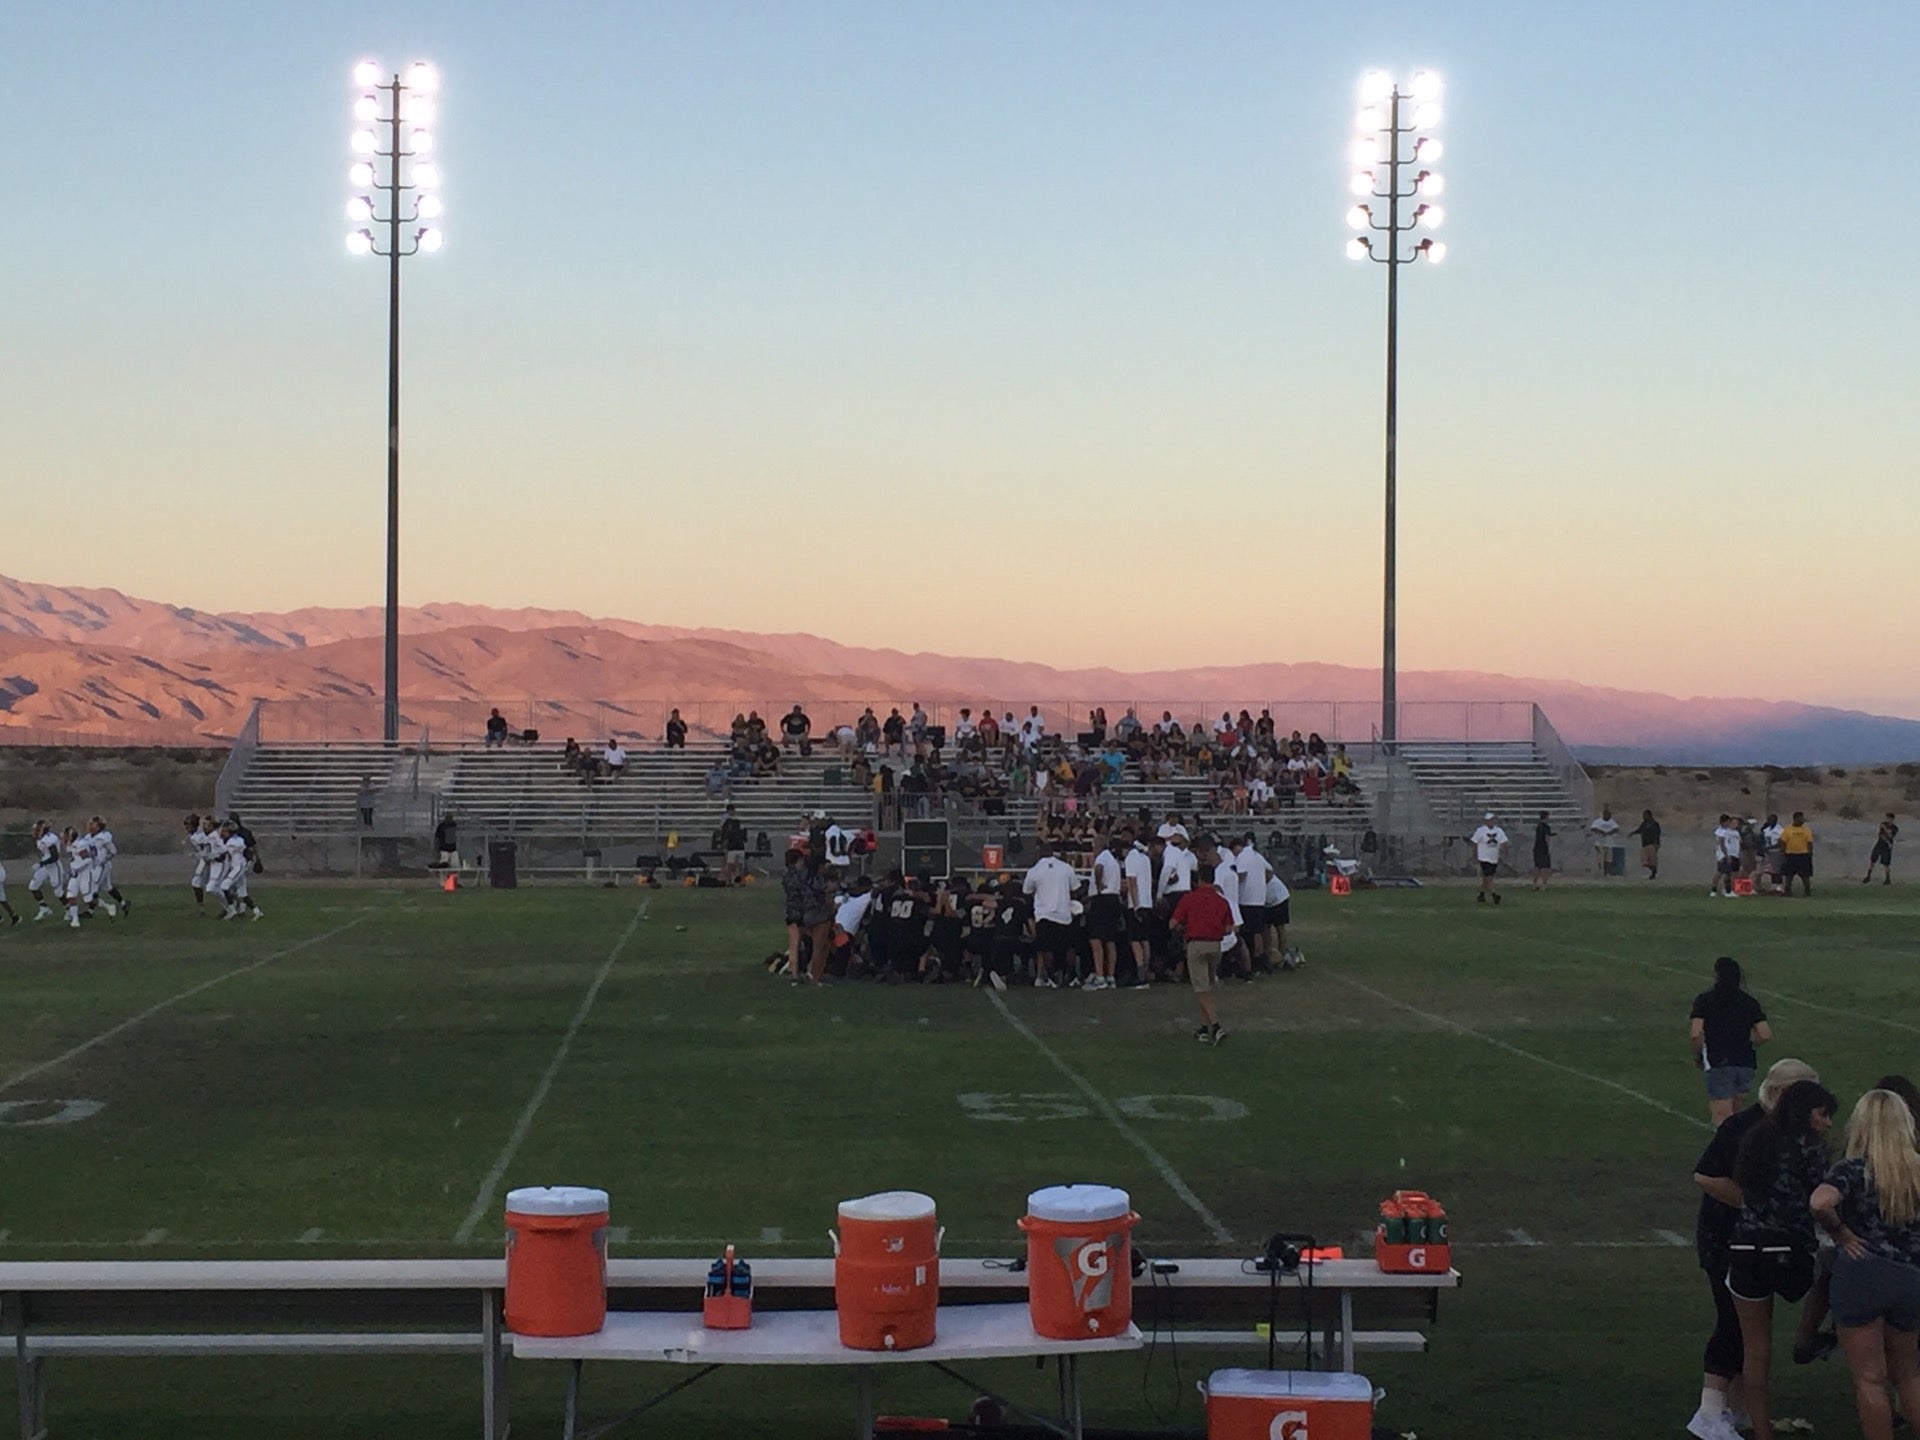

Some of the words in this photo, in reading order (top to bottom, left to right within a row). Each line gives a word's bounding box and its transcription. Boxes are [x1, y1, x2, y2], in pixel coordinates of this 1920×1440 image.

[956, 1091, 1252, 1123] 50
[1078, 1241, 1108, 1277] G
[1408, 1248, 1426, 1267] G
[1269, 1409, 1308, 1440] G
